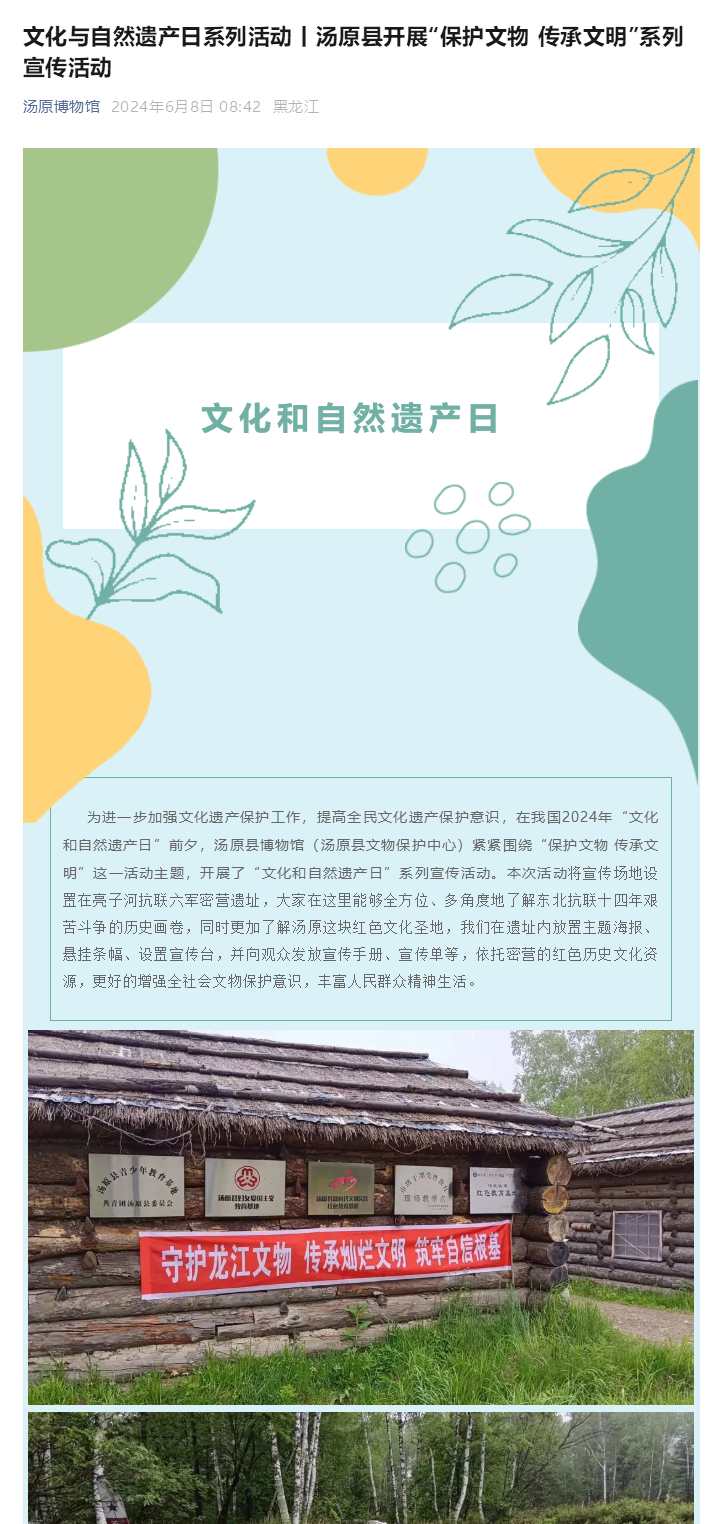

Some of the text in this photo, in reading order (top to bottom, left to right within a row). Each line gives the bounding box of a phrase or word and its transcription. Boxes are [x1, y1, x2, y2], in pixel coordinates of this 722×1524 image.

[538, 25, 684, 47] 传承文明”系列
[23, 56, 111, 78] 宣传活动
[23, 100, 320, 114] 汤原博物馆 2024年6月8日 08:42 黑龙江
[202, 402, 497, 434] 文化和自然遗产日
[614, 838, 659, 852] 传承文
[96, 1165, 180, 1195] 汤原县青少年教育基地
[103, 1199, 173, 1207] 共青团汤原县委员会
[403, 1194, 446, 1203] 现场教学点
[161, 1232, 501, 1284] 守护龙江文物 传承灿烂文明 筑牢自信根基
